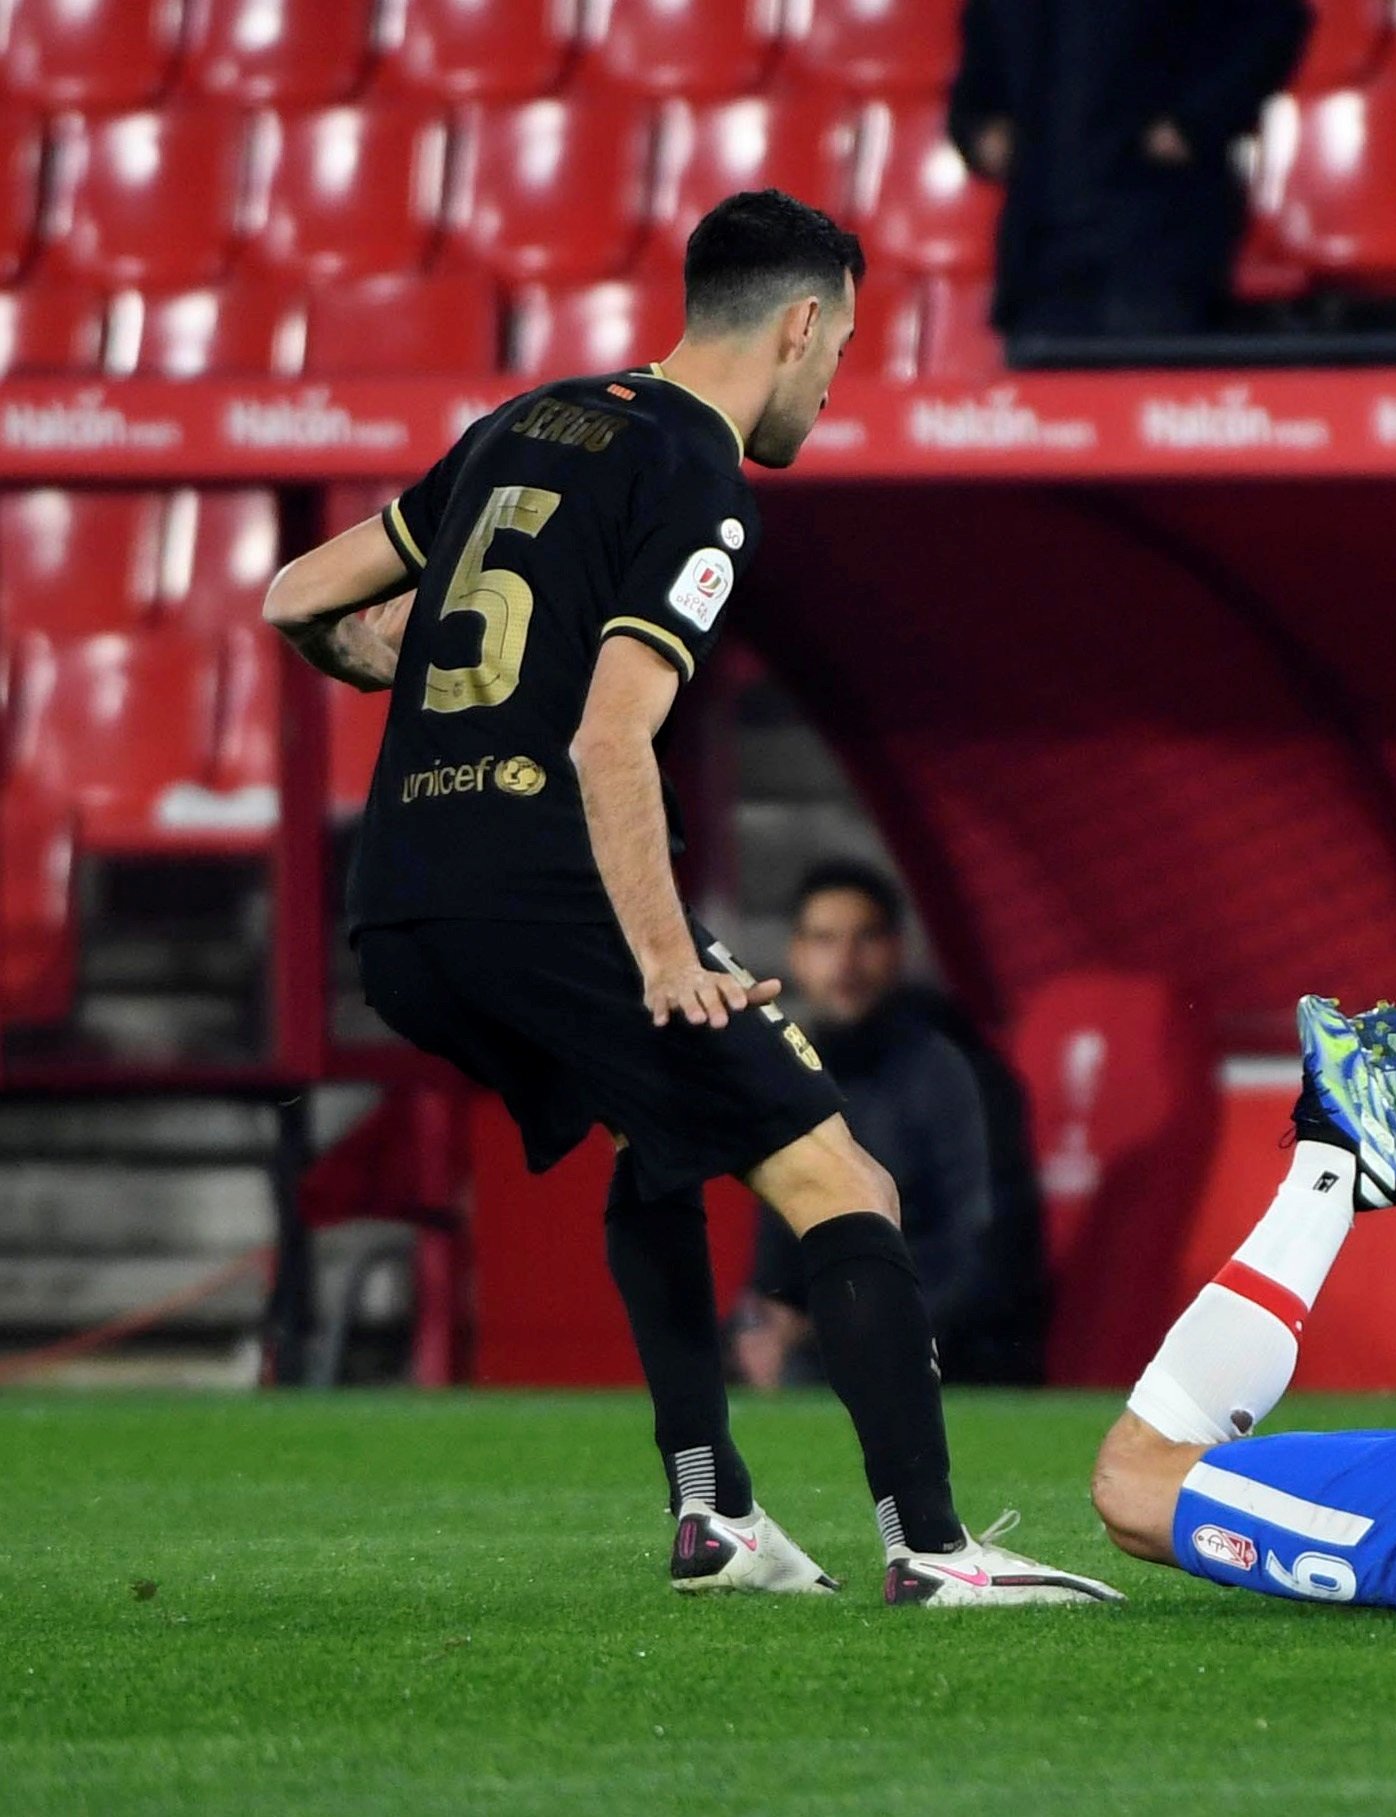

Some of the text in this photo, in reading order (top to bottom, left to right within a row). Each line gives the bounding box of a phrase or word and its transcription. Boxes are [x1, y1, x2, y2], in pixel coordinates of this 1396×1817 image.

[511, 398, 629, 453] SERGIO
[422, 486, 562, 714] 5
[402, 755, 495, 803] unicef
